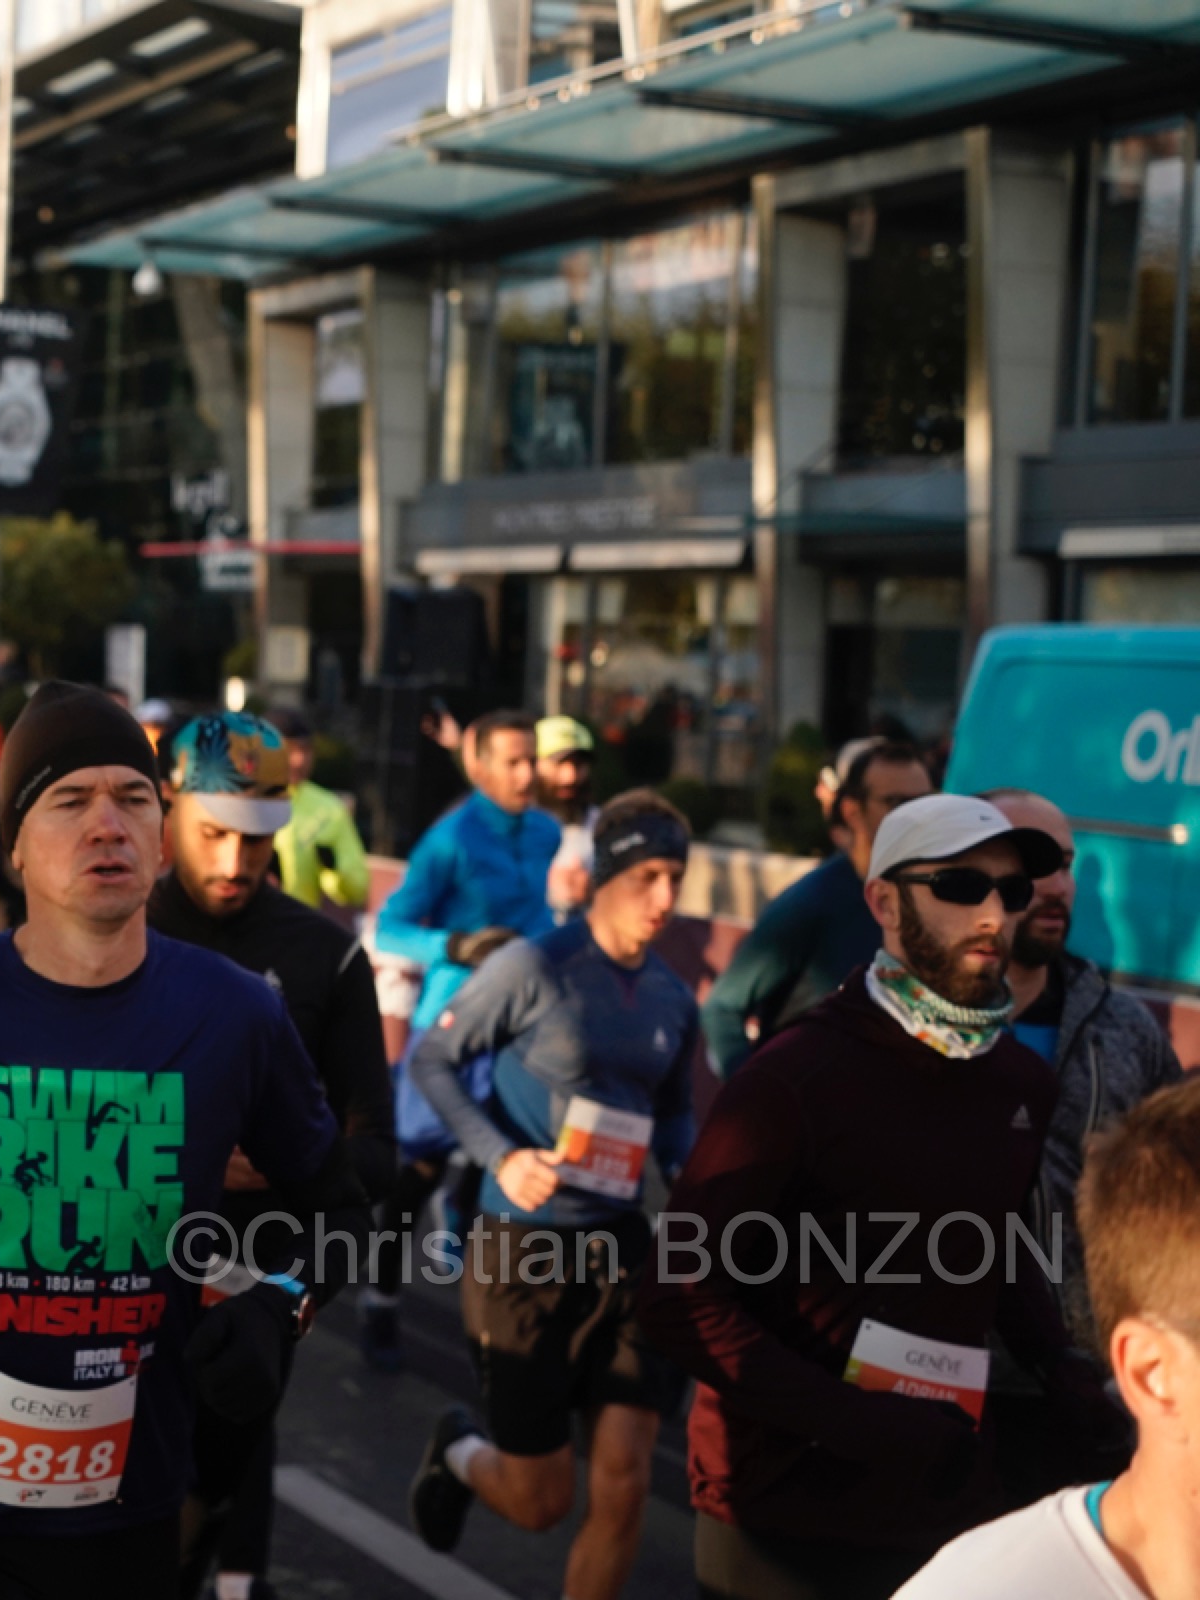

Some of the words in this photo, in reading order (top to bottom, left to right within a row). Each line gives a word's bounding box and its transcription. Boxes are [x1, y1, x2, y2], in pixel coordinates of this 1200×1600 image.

[6, 1272, 29, 1290] km
[46, 1273, 71, 1291] 180
[73, 1274, 95, 1292] km
[109, 1275, 129, 1291] 42
[73, 1364, 113, 1381] ITALY
